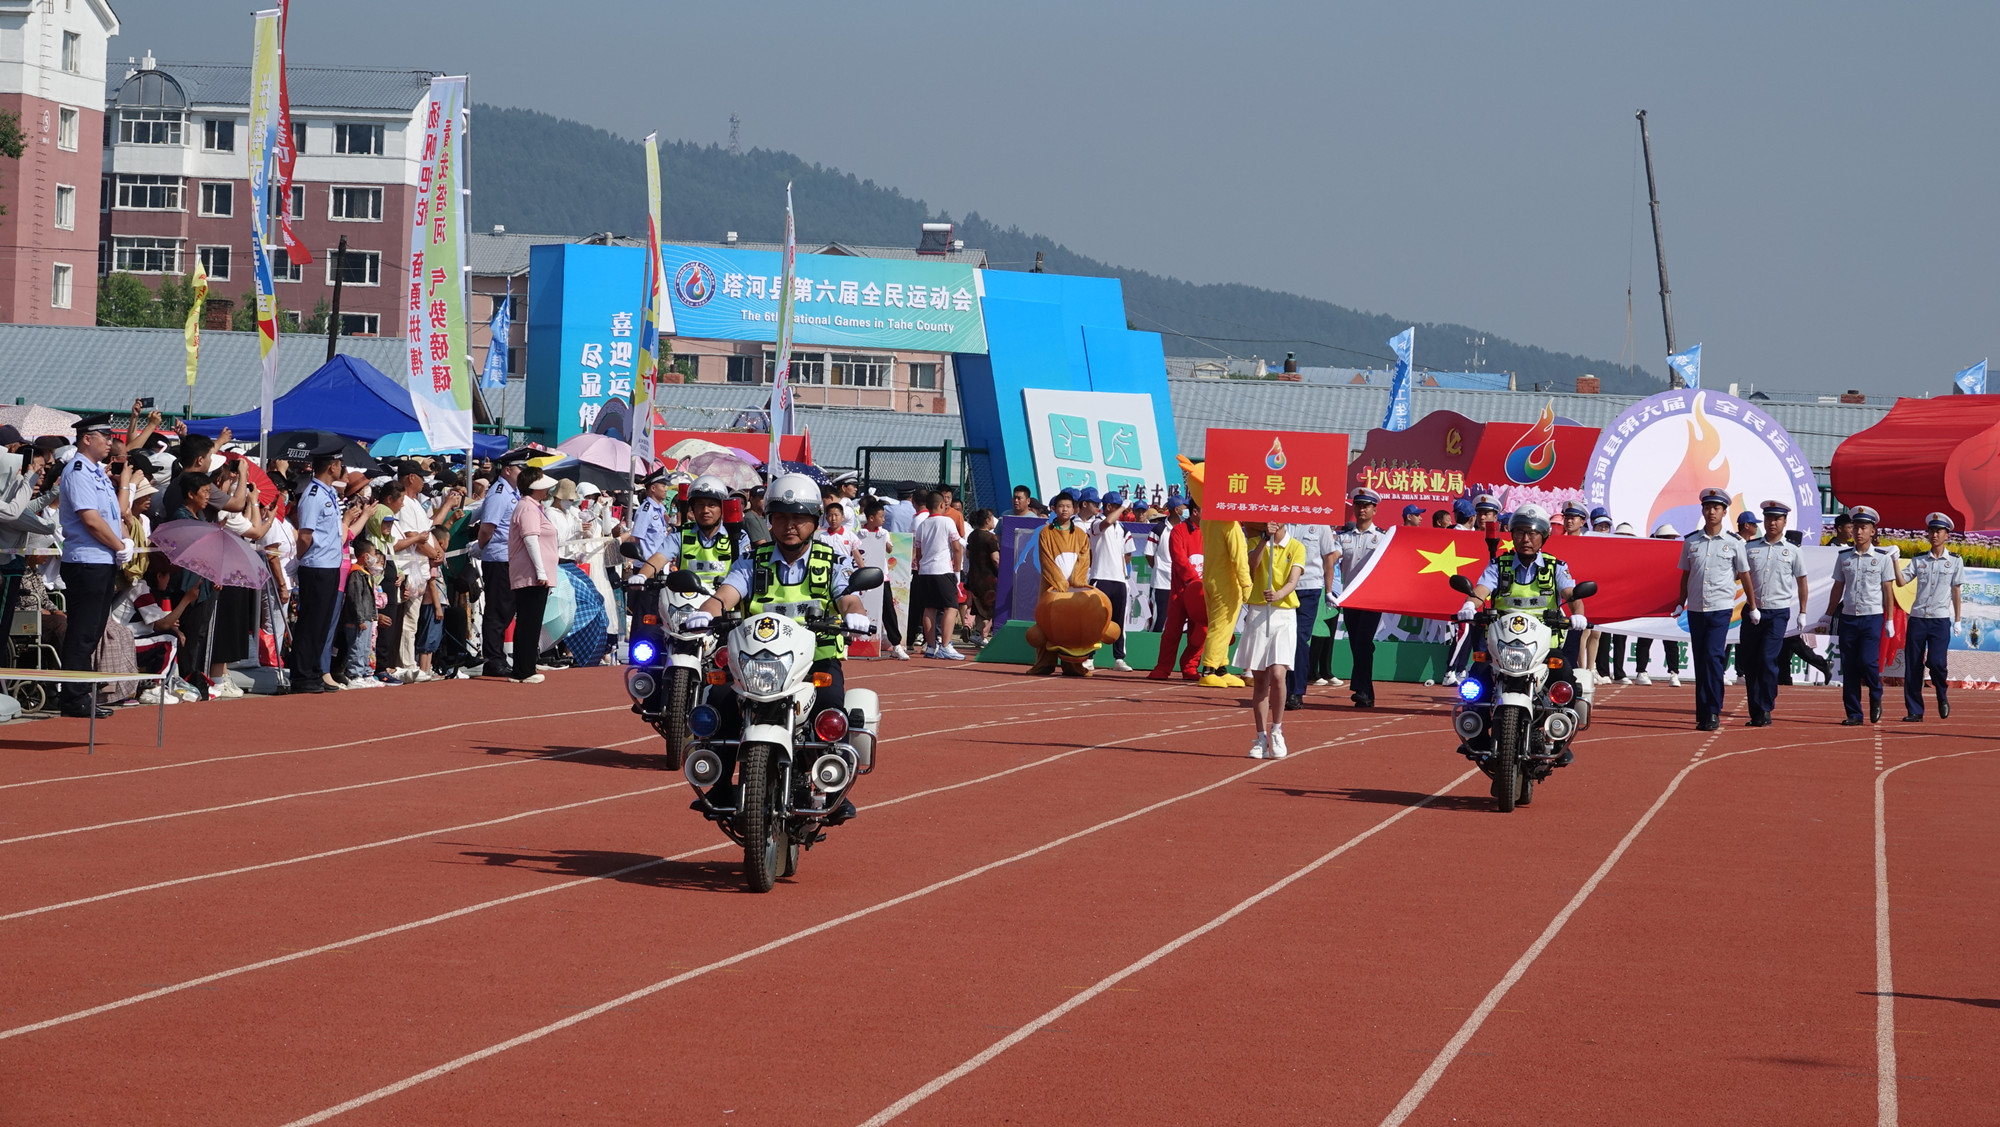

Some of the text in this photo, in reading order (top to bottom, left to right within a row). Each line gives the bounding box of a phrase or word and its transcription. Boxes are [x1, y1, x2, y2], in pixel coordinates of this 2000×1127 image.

[722, 272, 974, 312] 塔河县第六届全民运动会
[741, 309, 761, 322] The
[794, 313, 831, 328] ational
[834, 315, 871, 329] Games
[874, 317, 885, 329] in
[887, 318, 913, 331] Tahe
[916, 320, 955, 335] County
[1591, 396, 1815, 507] 塔河县第六届 全民运动会
[1228, 473, 1322, 497] 前导队
[1360, 469, 1465, 495] 十八站林业局
[1215, 502, 1334, 515] 塔河县第六届全民运动会
